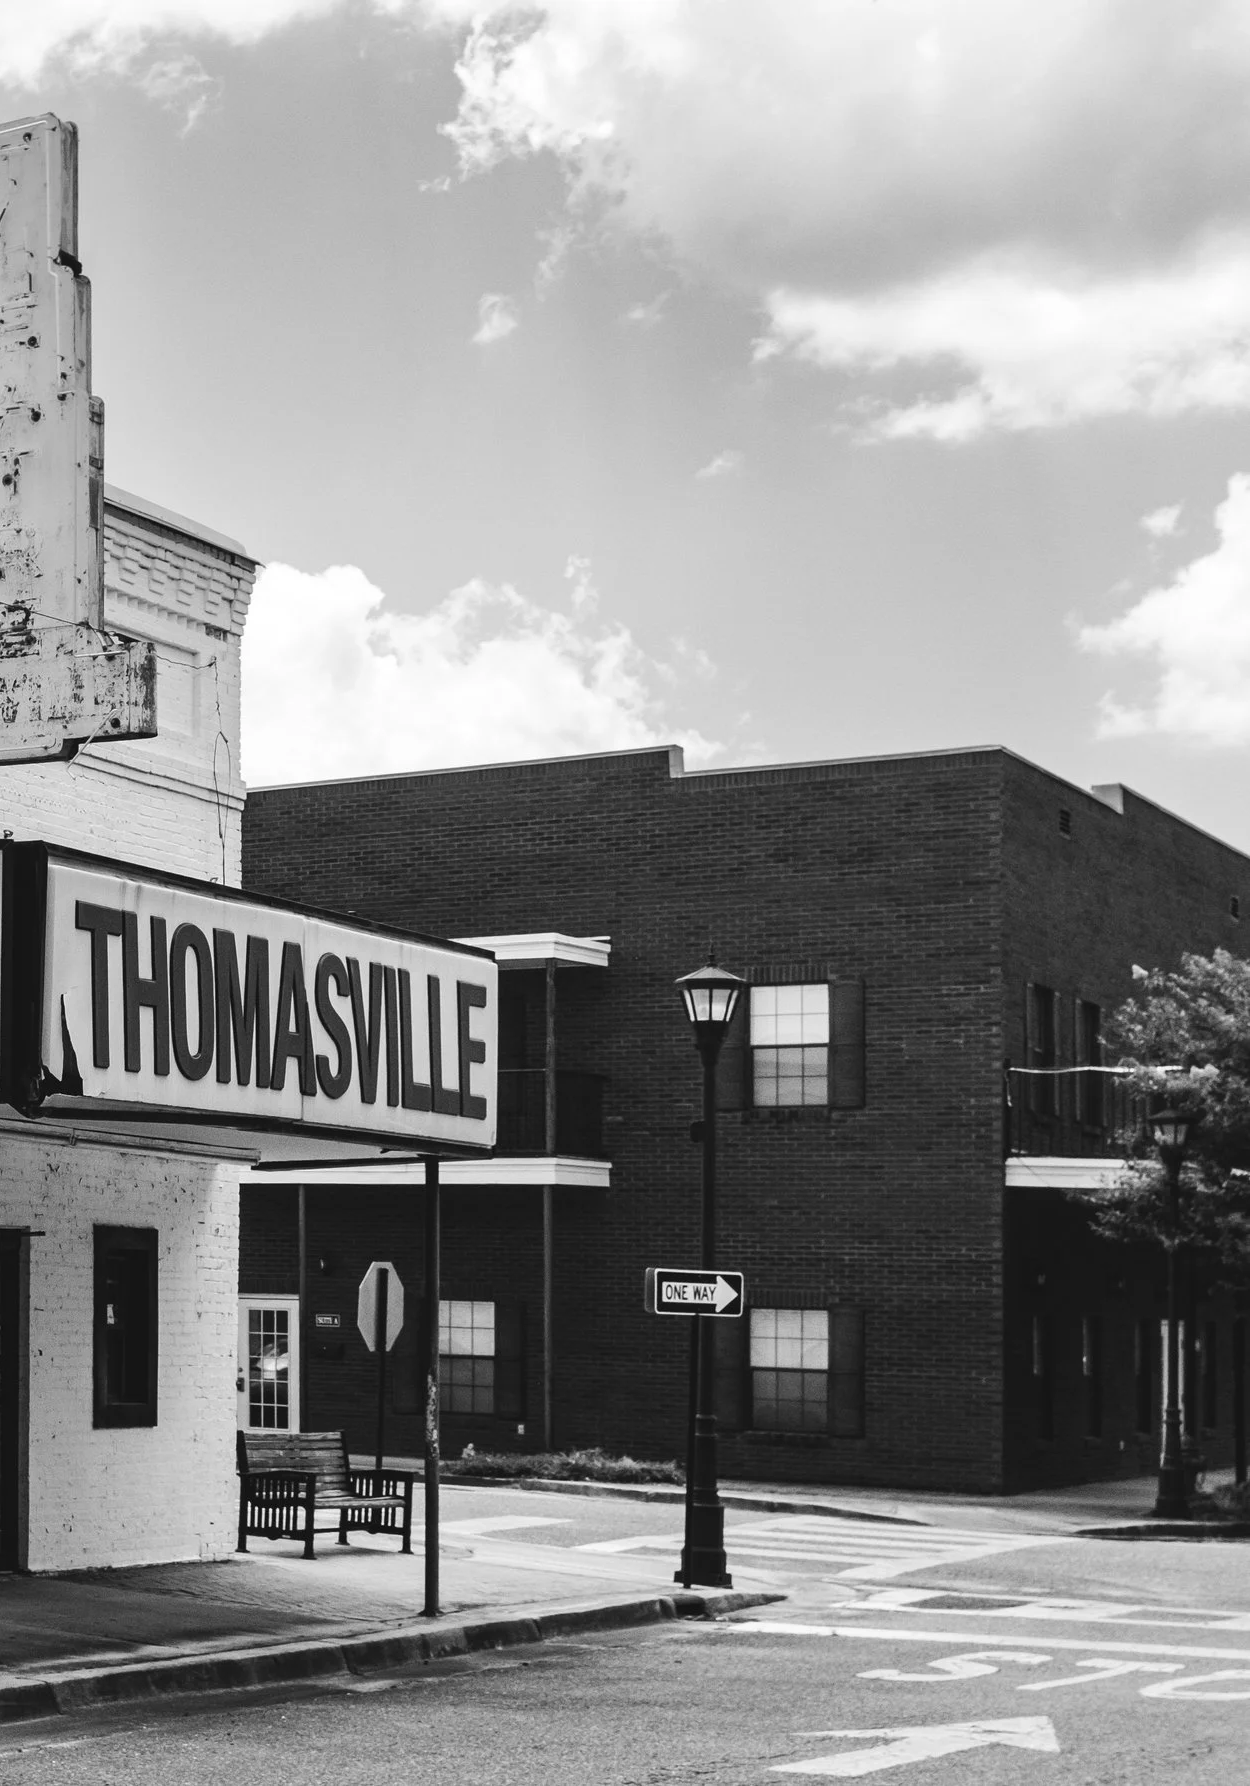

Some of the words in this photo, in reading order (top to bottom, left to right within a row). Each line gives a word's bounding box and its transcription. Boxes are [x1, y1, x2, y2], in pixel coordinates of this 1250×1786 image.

[75, 899, 488, 1121] THOMASVILLE
[665, 1284, 688, 1301] ONE
[692, 1285, 717, 1302] WAY
